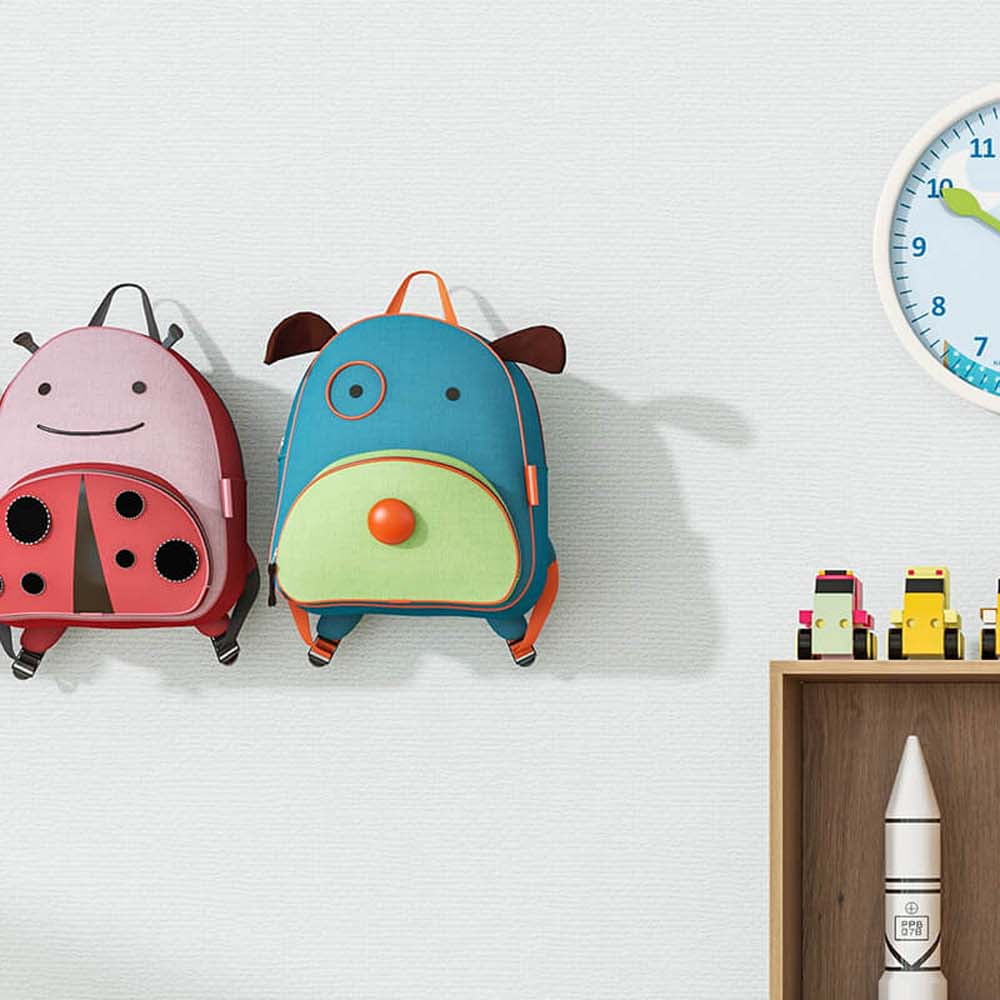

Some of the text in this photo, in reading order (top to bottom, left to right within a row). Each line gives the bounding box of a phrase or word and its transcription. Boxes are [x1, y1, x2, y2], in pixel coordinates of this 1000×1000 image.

[970, 138, 996, 158] 11
[912, 237, 926, 258] 9
[932, 296, 946, 317] 8
[974, 337, 988, 357] 7
